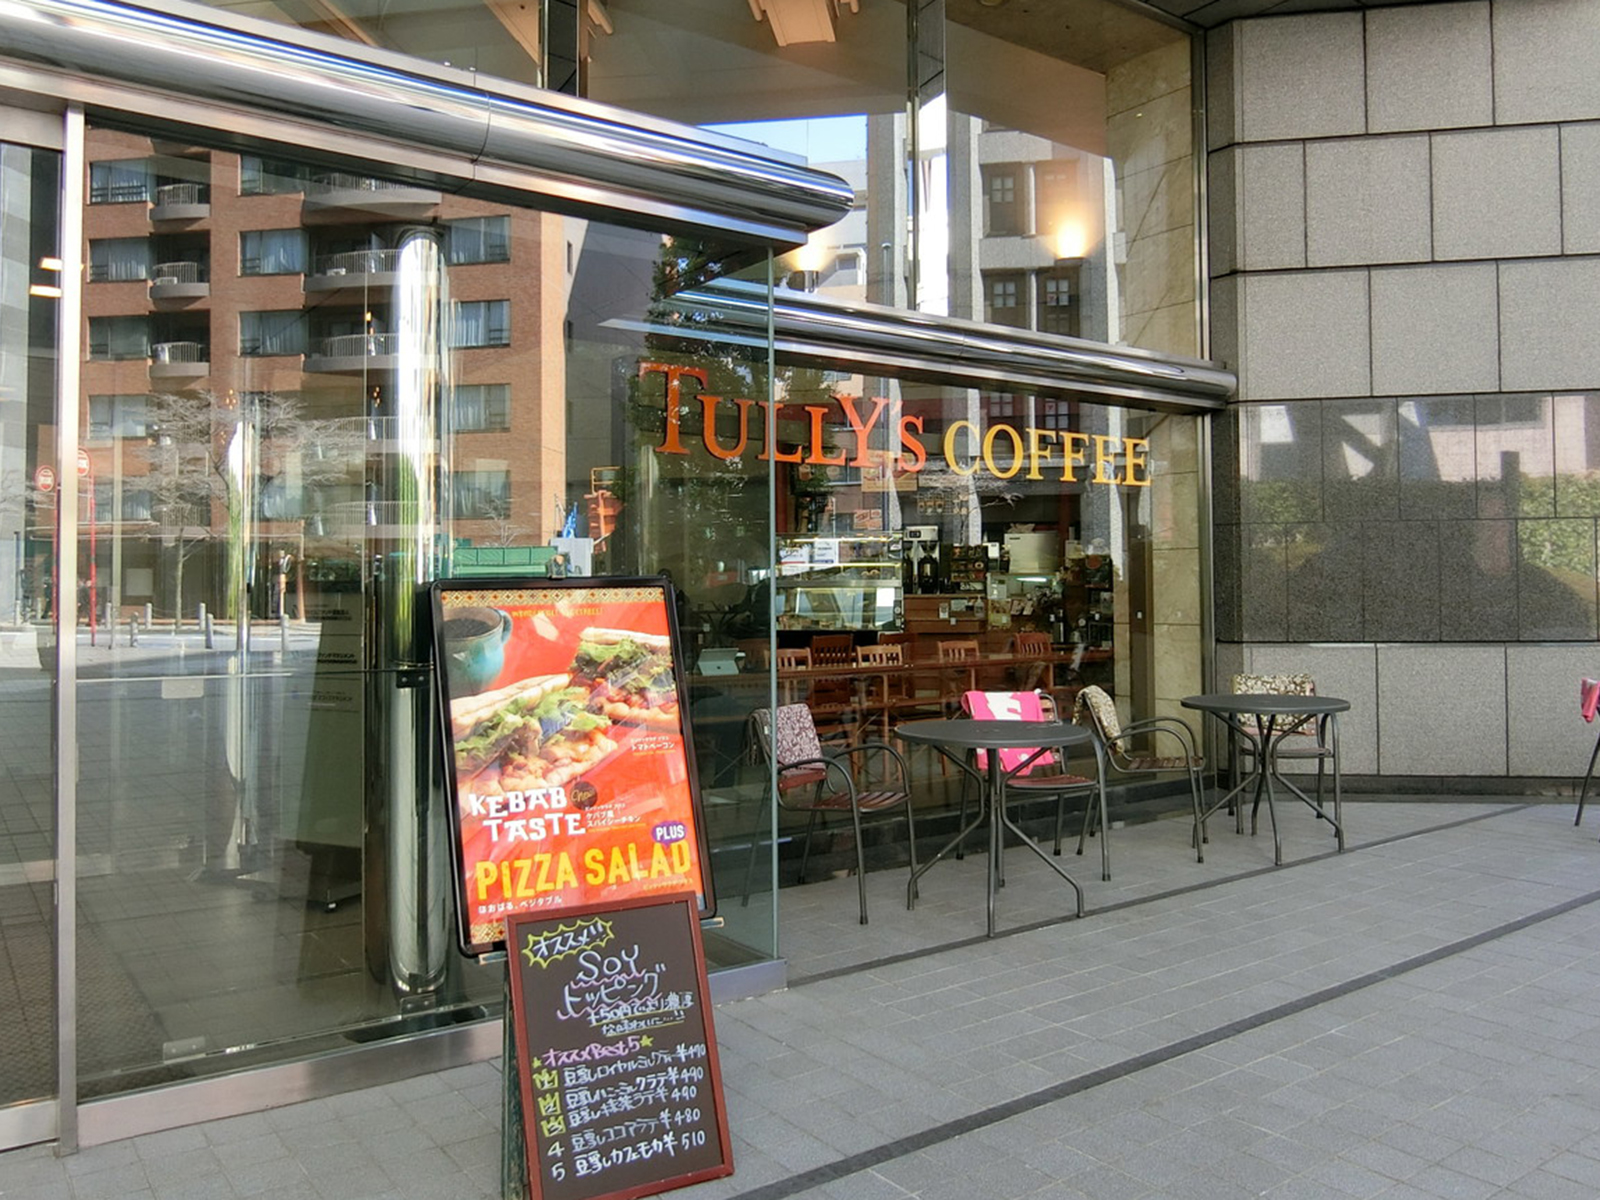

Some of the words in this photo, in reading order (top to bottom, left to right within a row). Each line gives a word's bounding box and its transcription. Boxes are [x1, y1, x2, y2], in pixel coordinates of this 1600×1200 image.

[943, 419, 1151, 487] COFFEE
[468, 786, 568, 818] KEBAB
[482, 812, 586, 843] TASTE
[655, 824, 686, 841] PLUS
[475, 851, 580, 901] PIZZA
[584, 840, 692, 887] SALAD
[563, 963, 667, 1016] トッピング
[547, 1141, 565, 1157] 4
[551, 1161, 566, 1182] 5
